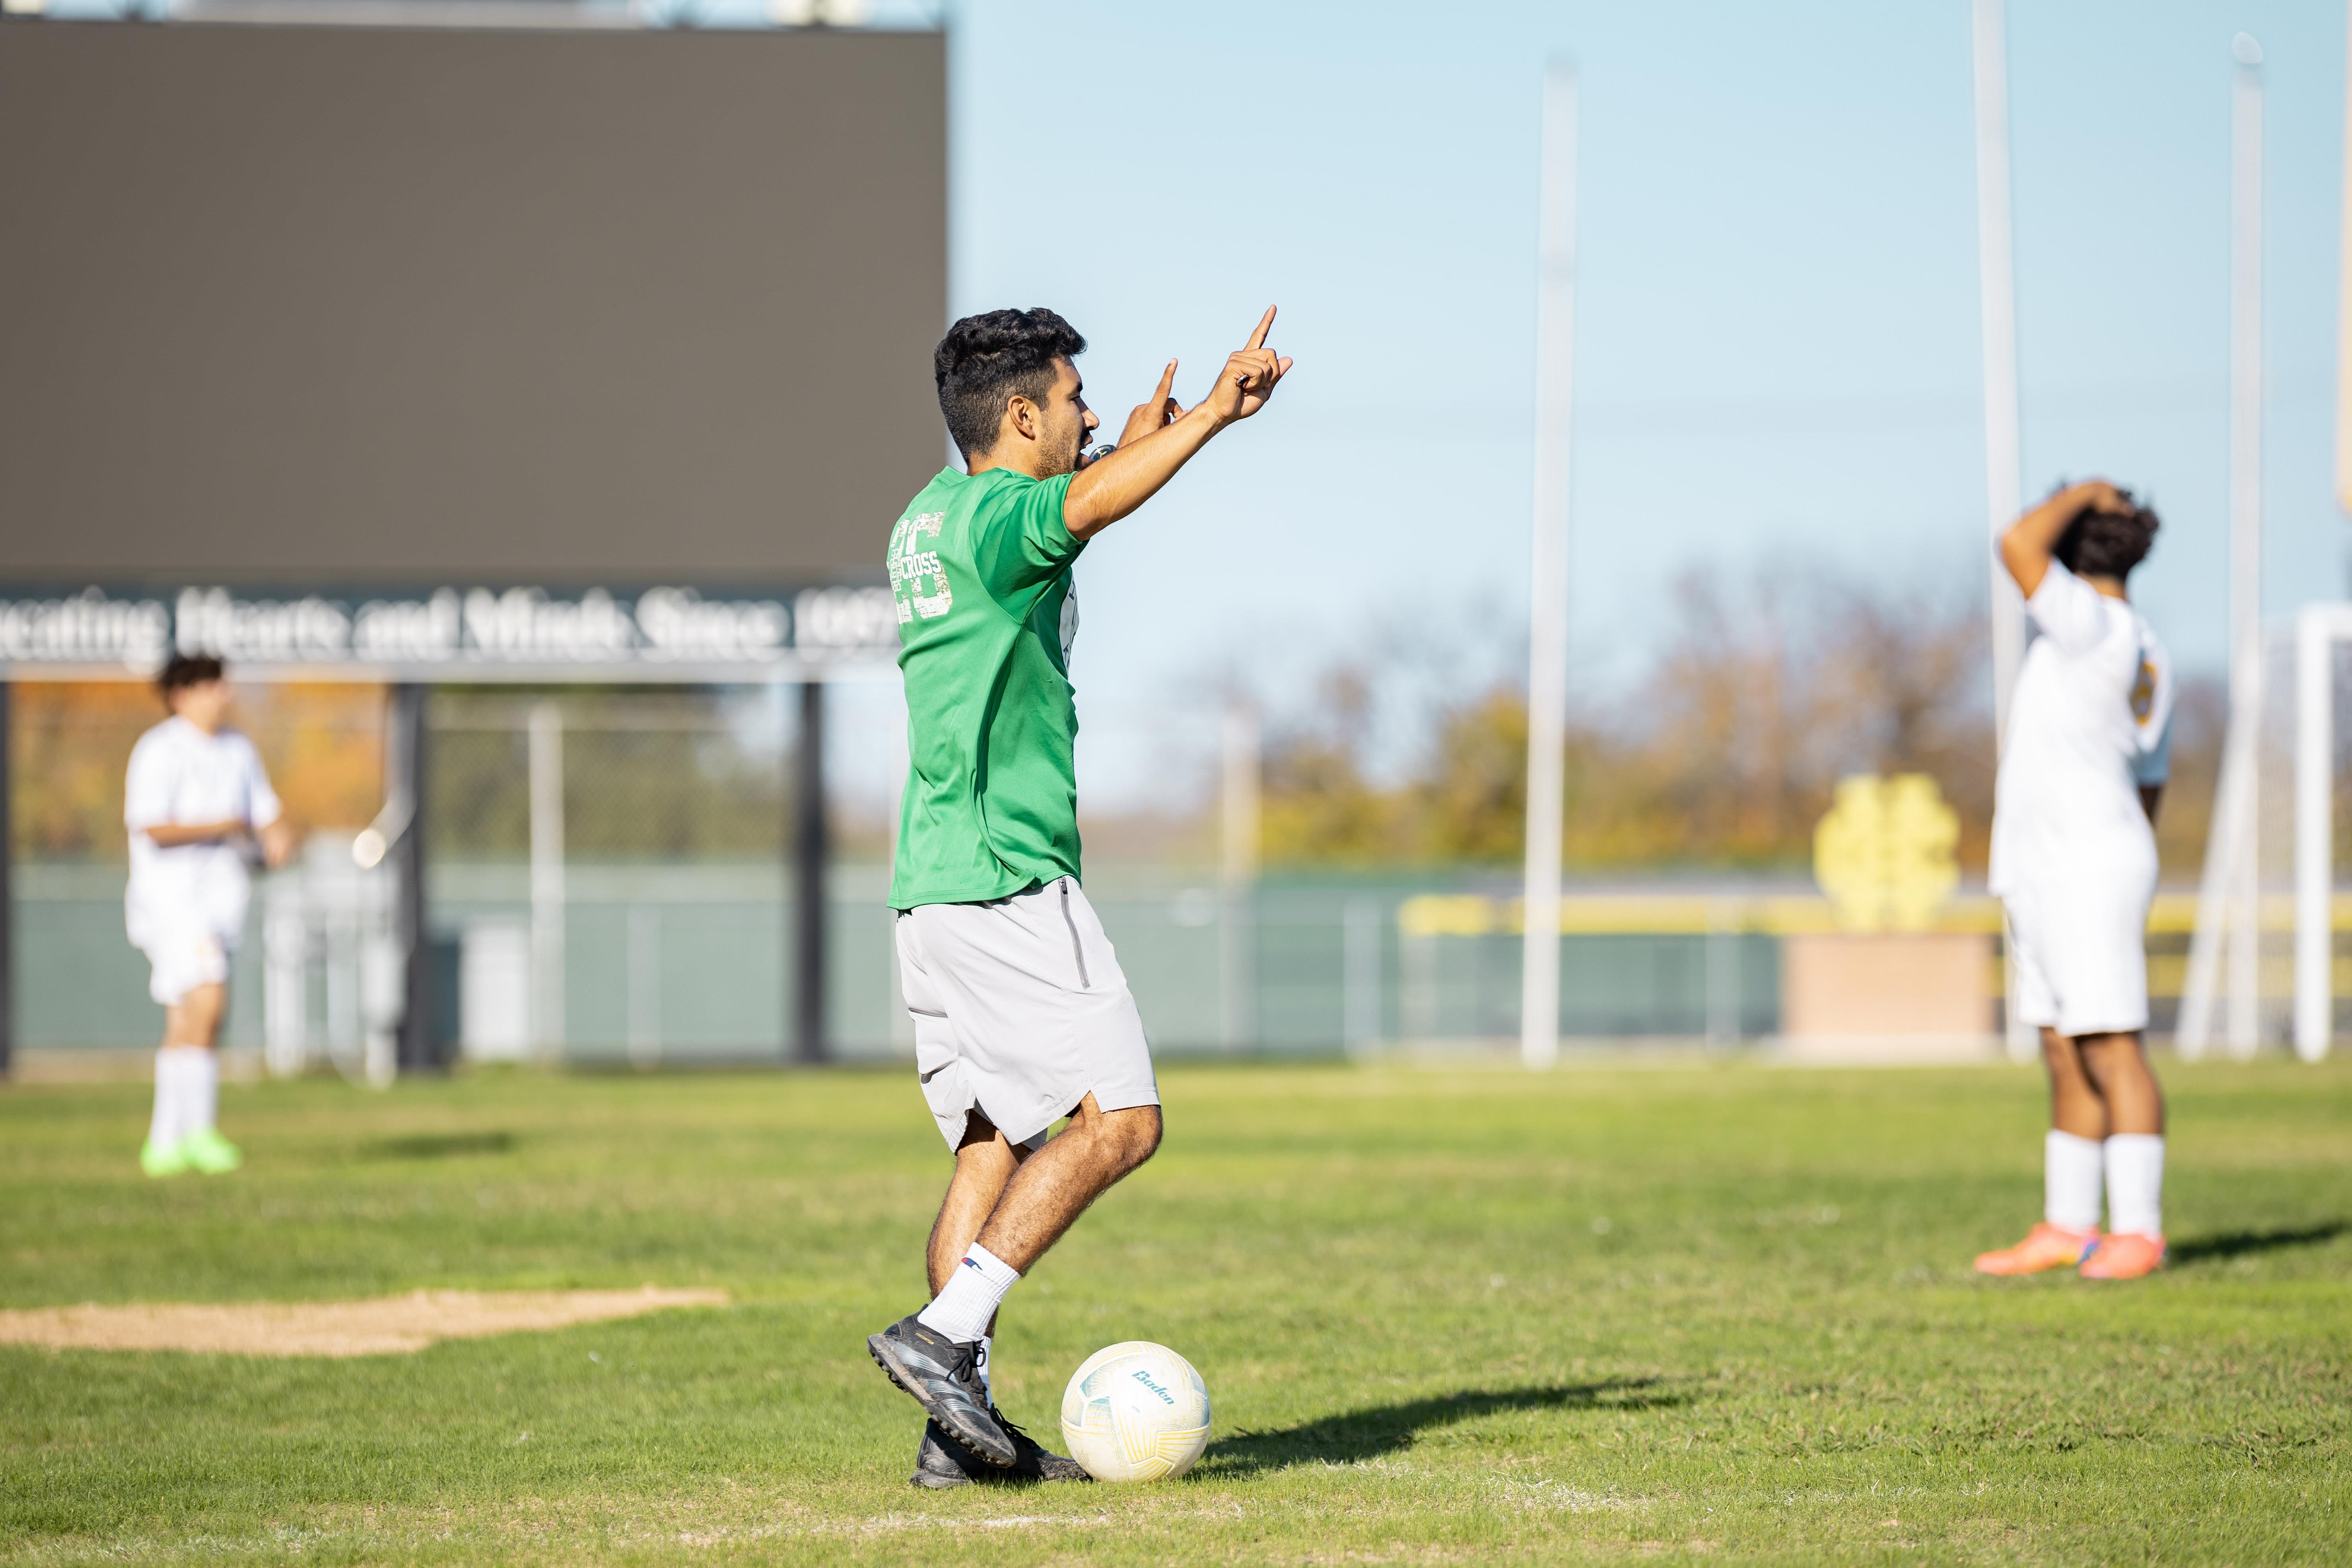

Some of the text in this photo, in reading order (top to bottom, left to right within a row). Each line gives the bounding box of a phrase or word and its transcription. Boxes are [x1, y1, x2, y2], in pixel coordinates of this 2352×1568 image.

[900, 550, 942, 579] CROSS
[354, 589, 460, 660] and
[1131, 1370, 1174, 1405] Baden
